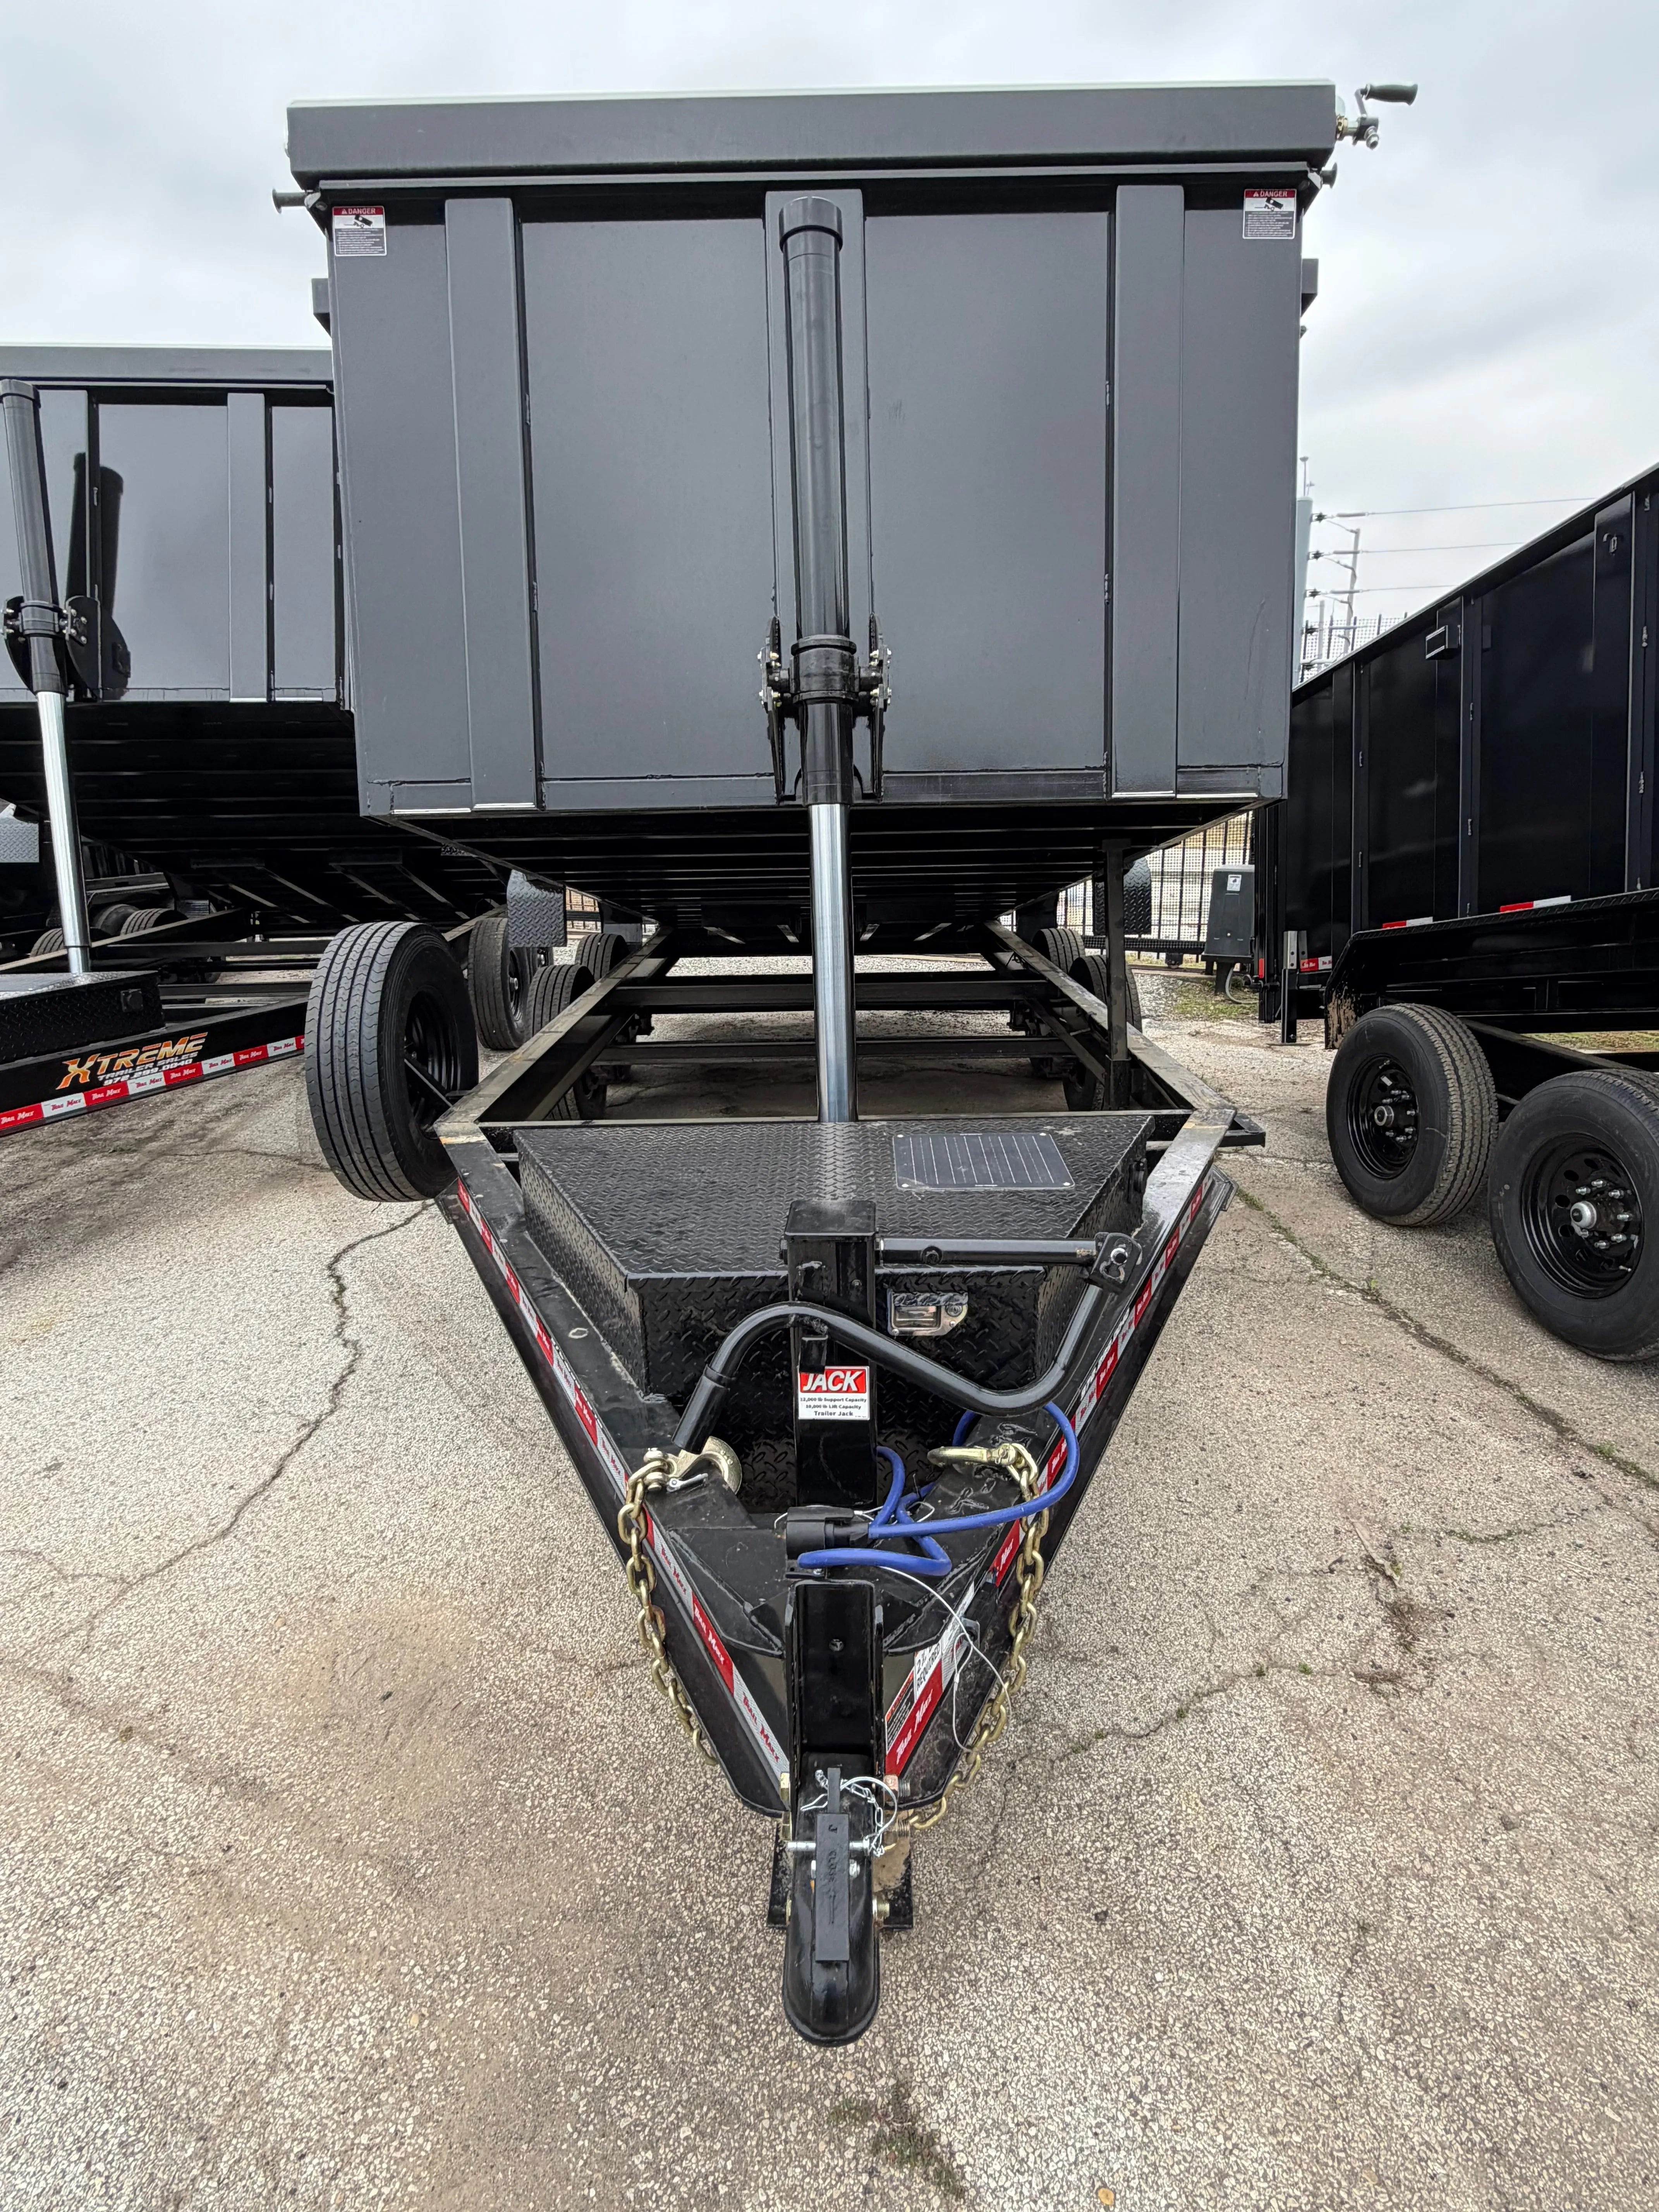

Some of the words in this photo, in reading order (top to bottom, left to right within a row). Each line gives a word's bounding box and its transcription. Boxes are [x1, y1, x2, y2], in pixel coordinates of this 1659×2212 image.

[55, 1032, 208, 1090] XTREME
[98, 1063, 154, 1081] TRAILER
[157, 1052, 198, 1065] SALES
[103, 1059, 193, 1086] 972.299.0040
[803, 1370, 863, 1391] JACK
